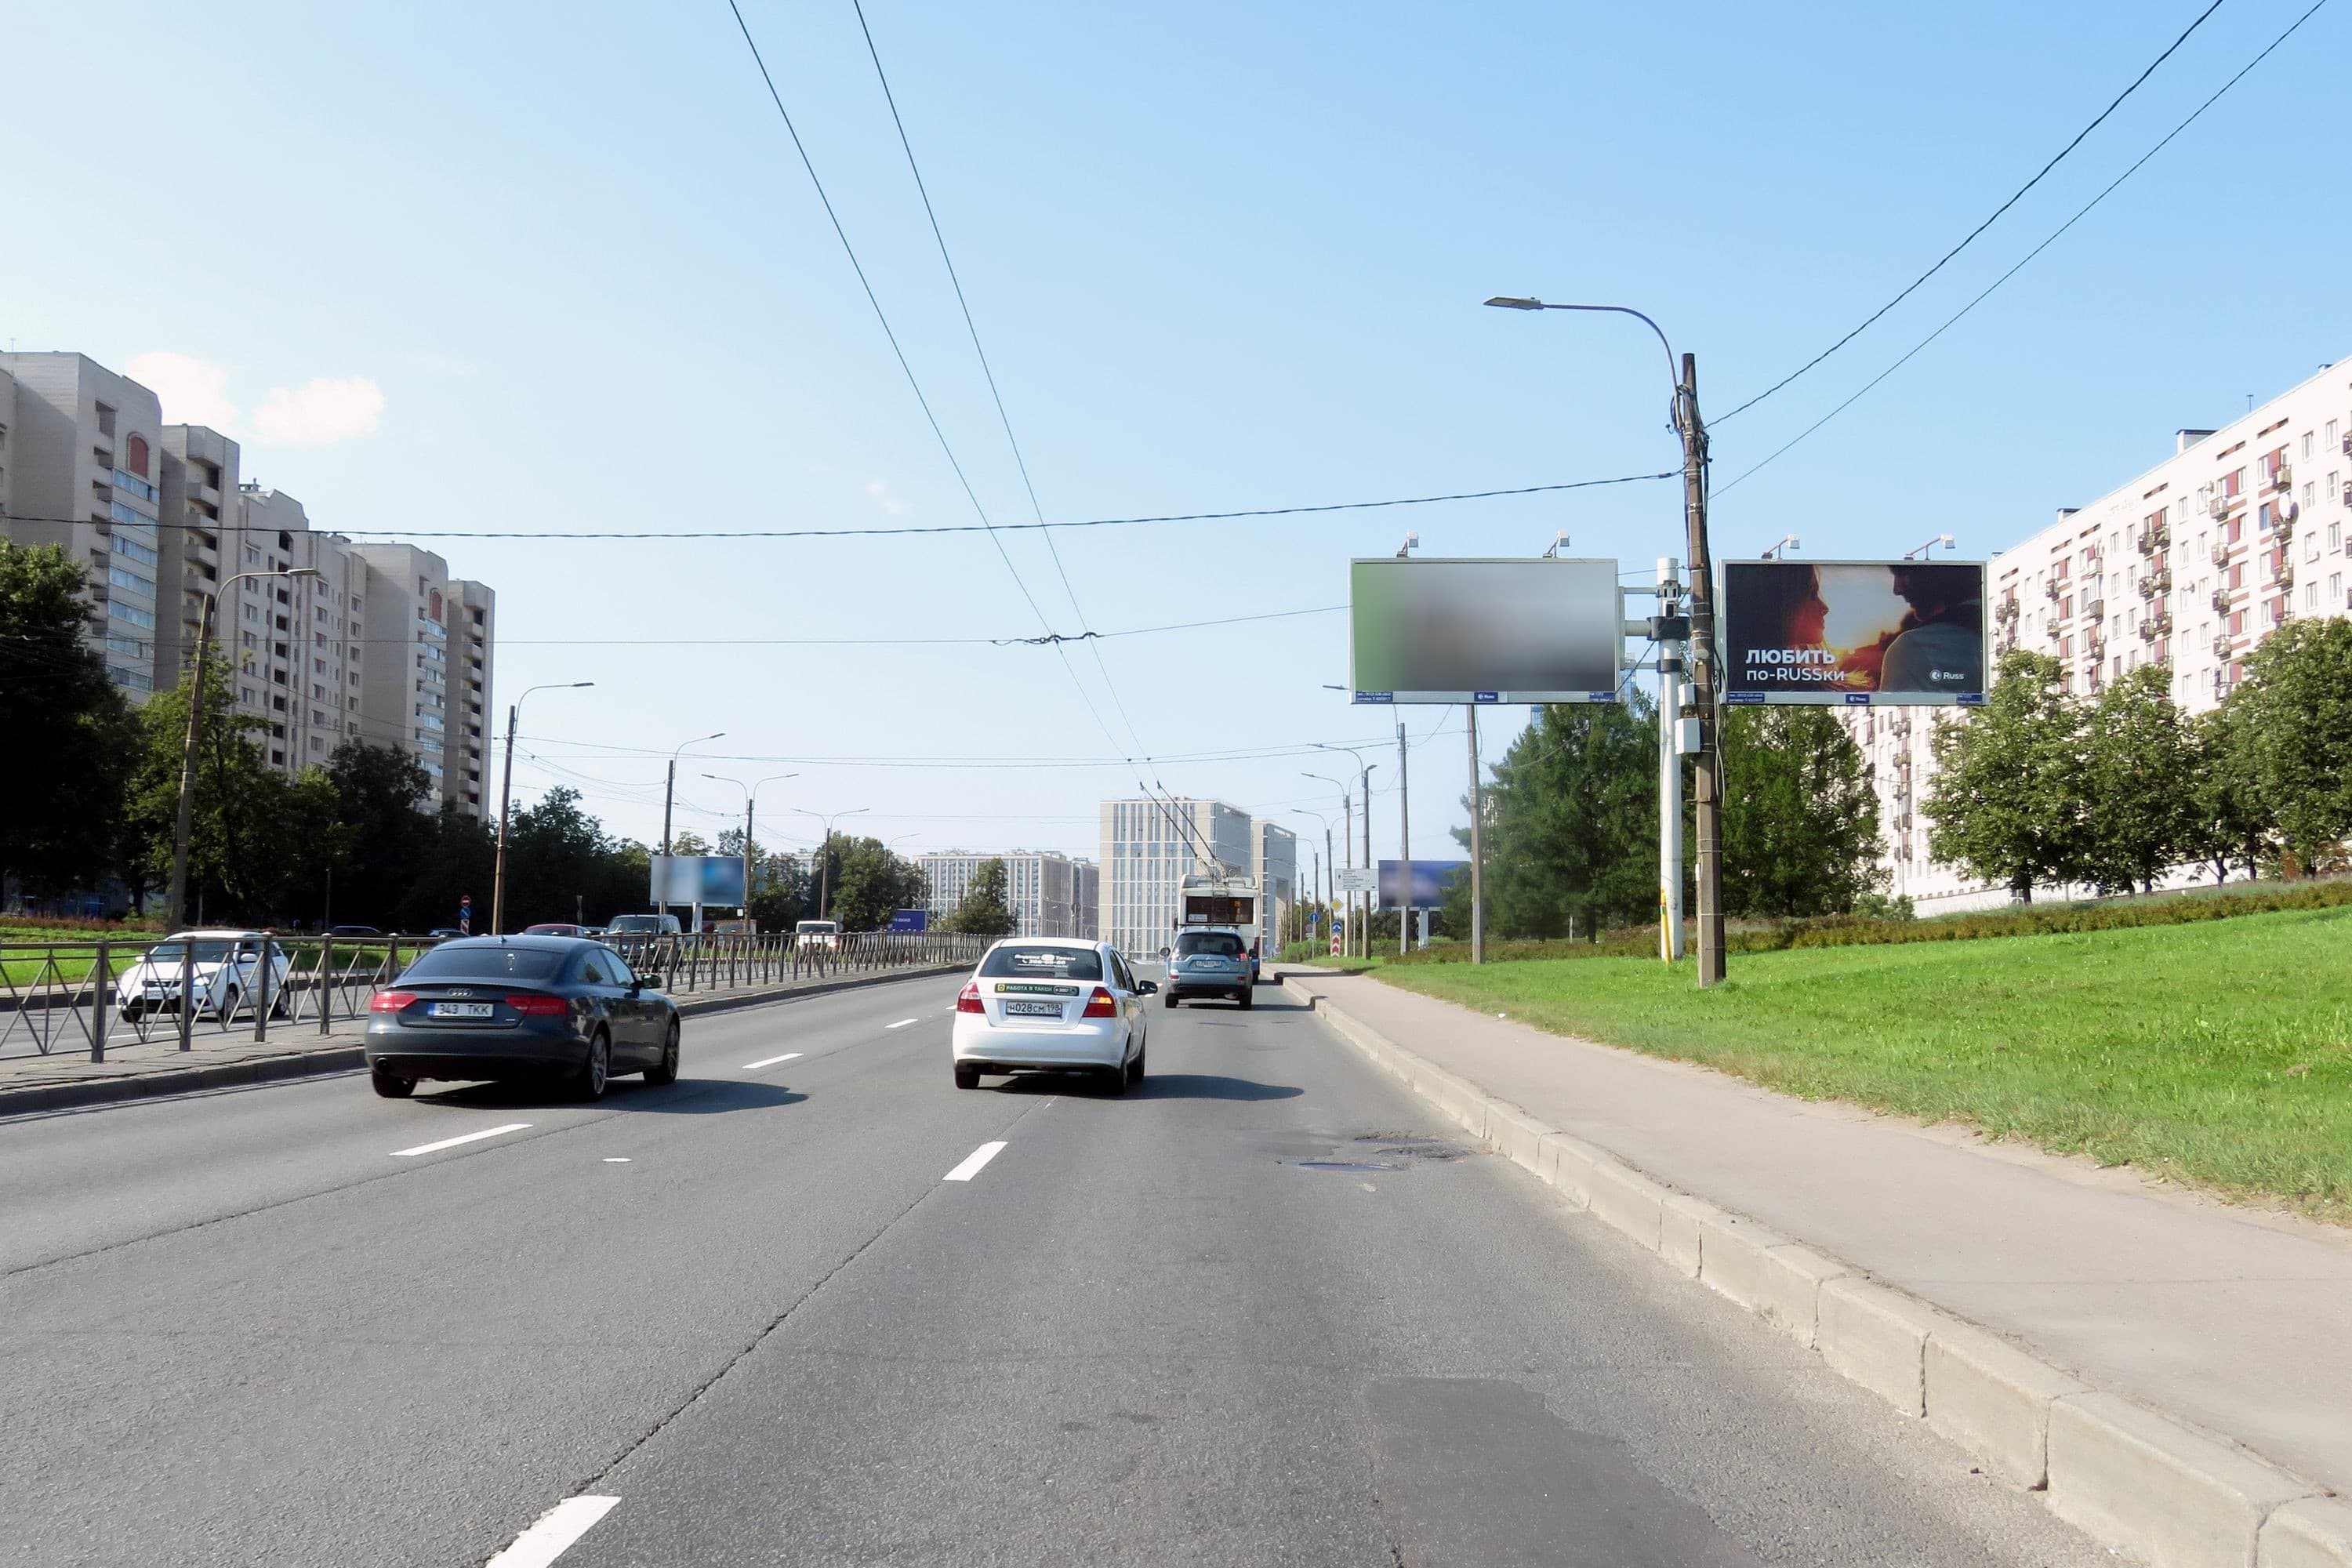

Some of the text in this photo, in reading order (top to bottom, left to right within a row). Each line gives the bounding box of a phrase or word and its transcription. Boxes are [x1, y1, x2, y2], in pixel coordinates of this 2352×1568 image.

[1745, 649, 1835, 664] ЛЮБИТЬ
[1746, 667, 1845, 681] по-RUSSки
[1943, 671, 1965, 680] Russ
[439, 1004, 489, 1015] 343 TKK
